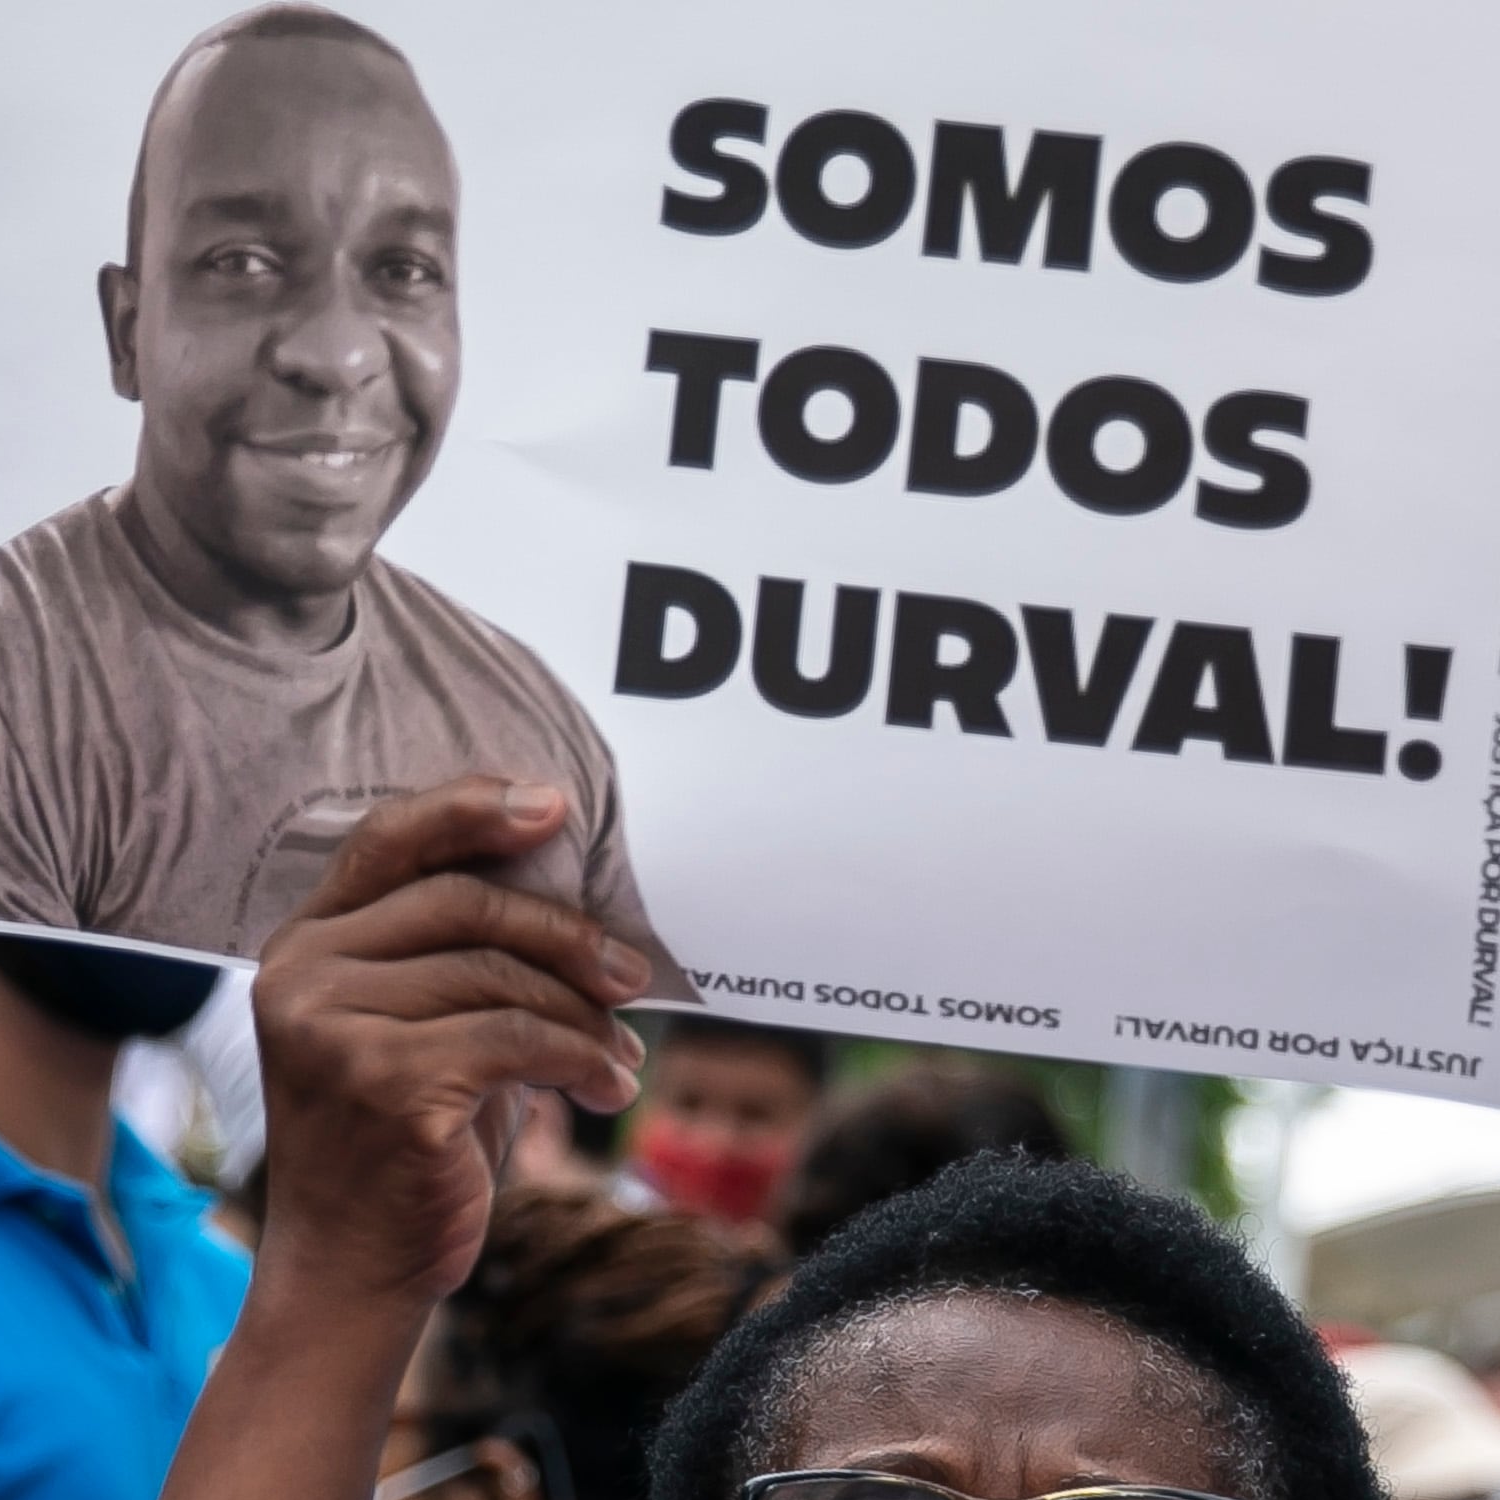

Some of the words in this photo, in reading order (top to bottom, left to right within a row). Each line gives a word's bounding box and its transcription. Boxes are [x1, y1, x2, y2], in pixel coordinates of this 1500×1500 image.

[660, 96, 1375, 297] SOMOS
[645, 328, 1312, 531] TODOS
[613, 561, 1454, 783] DURVAL!
[692, 971, 805, 1002] DURVA
[1467, 907, 1500, 1028] DURVAL!
[814, 983, 931, 1016] TODOS
[939, 997, 1061, 1029] SOMOS
[1114, 1014, 1259, 1051] DURVAL!
[1268, 1030, 1340, 1059] POR
[1350, 1038, 1485, 1079] JUSTIÇA
